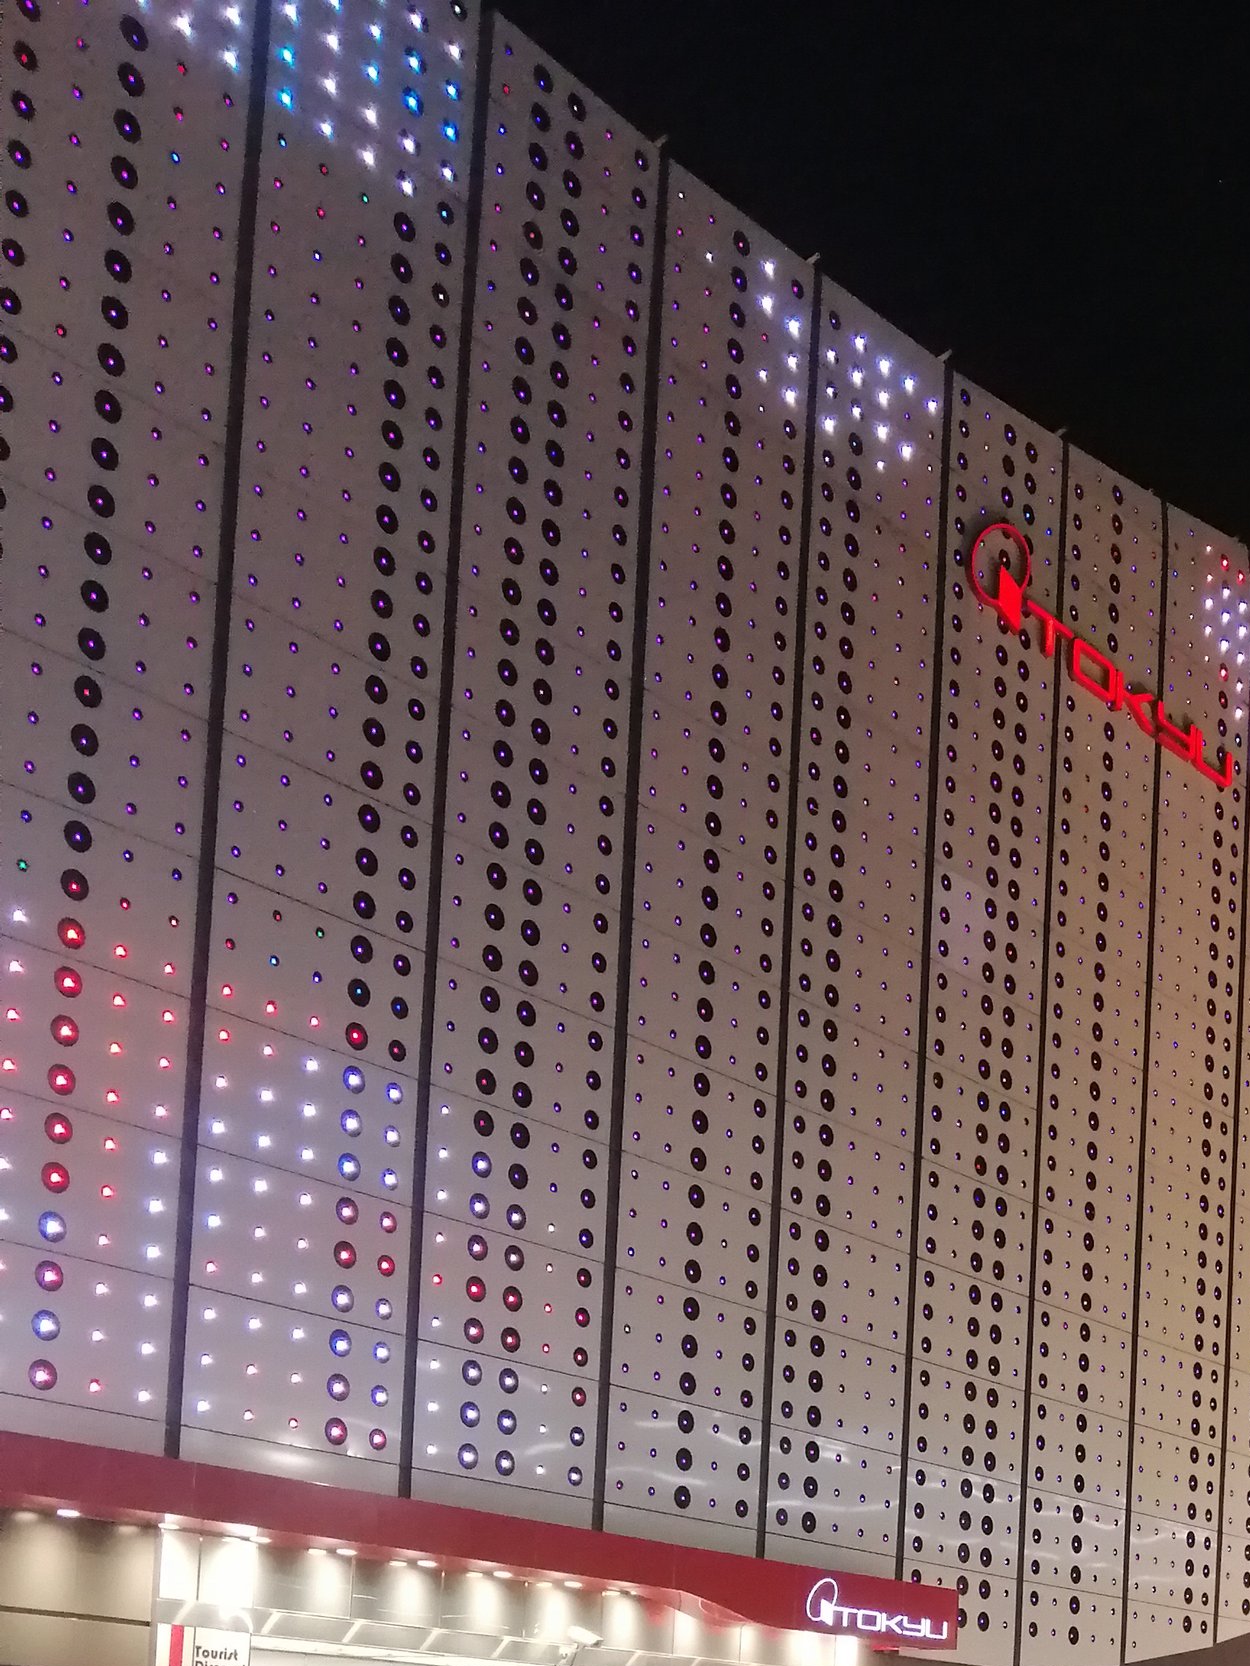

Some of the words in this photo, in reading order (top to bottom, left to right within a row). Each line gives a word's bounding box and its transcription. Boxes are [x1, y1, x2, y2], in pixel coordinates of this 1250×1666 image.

[1026, 600, 1233, 788] TOKYU
[833, 1605, 948, 1640] TOKYU
[195, 1645, 239, 1661] Tourist
